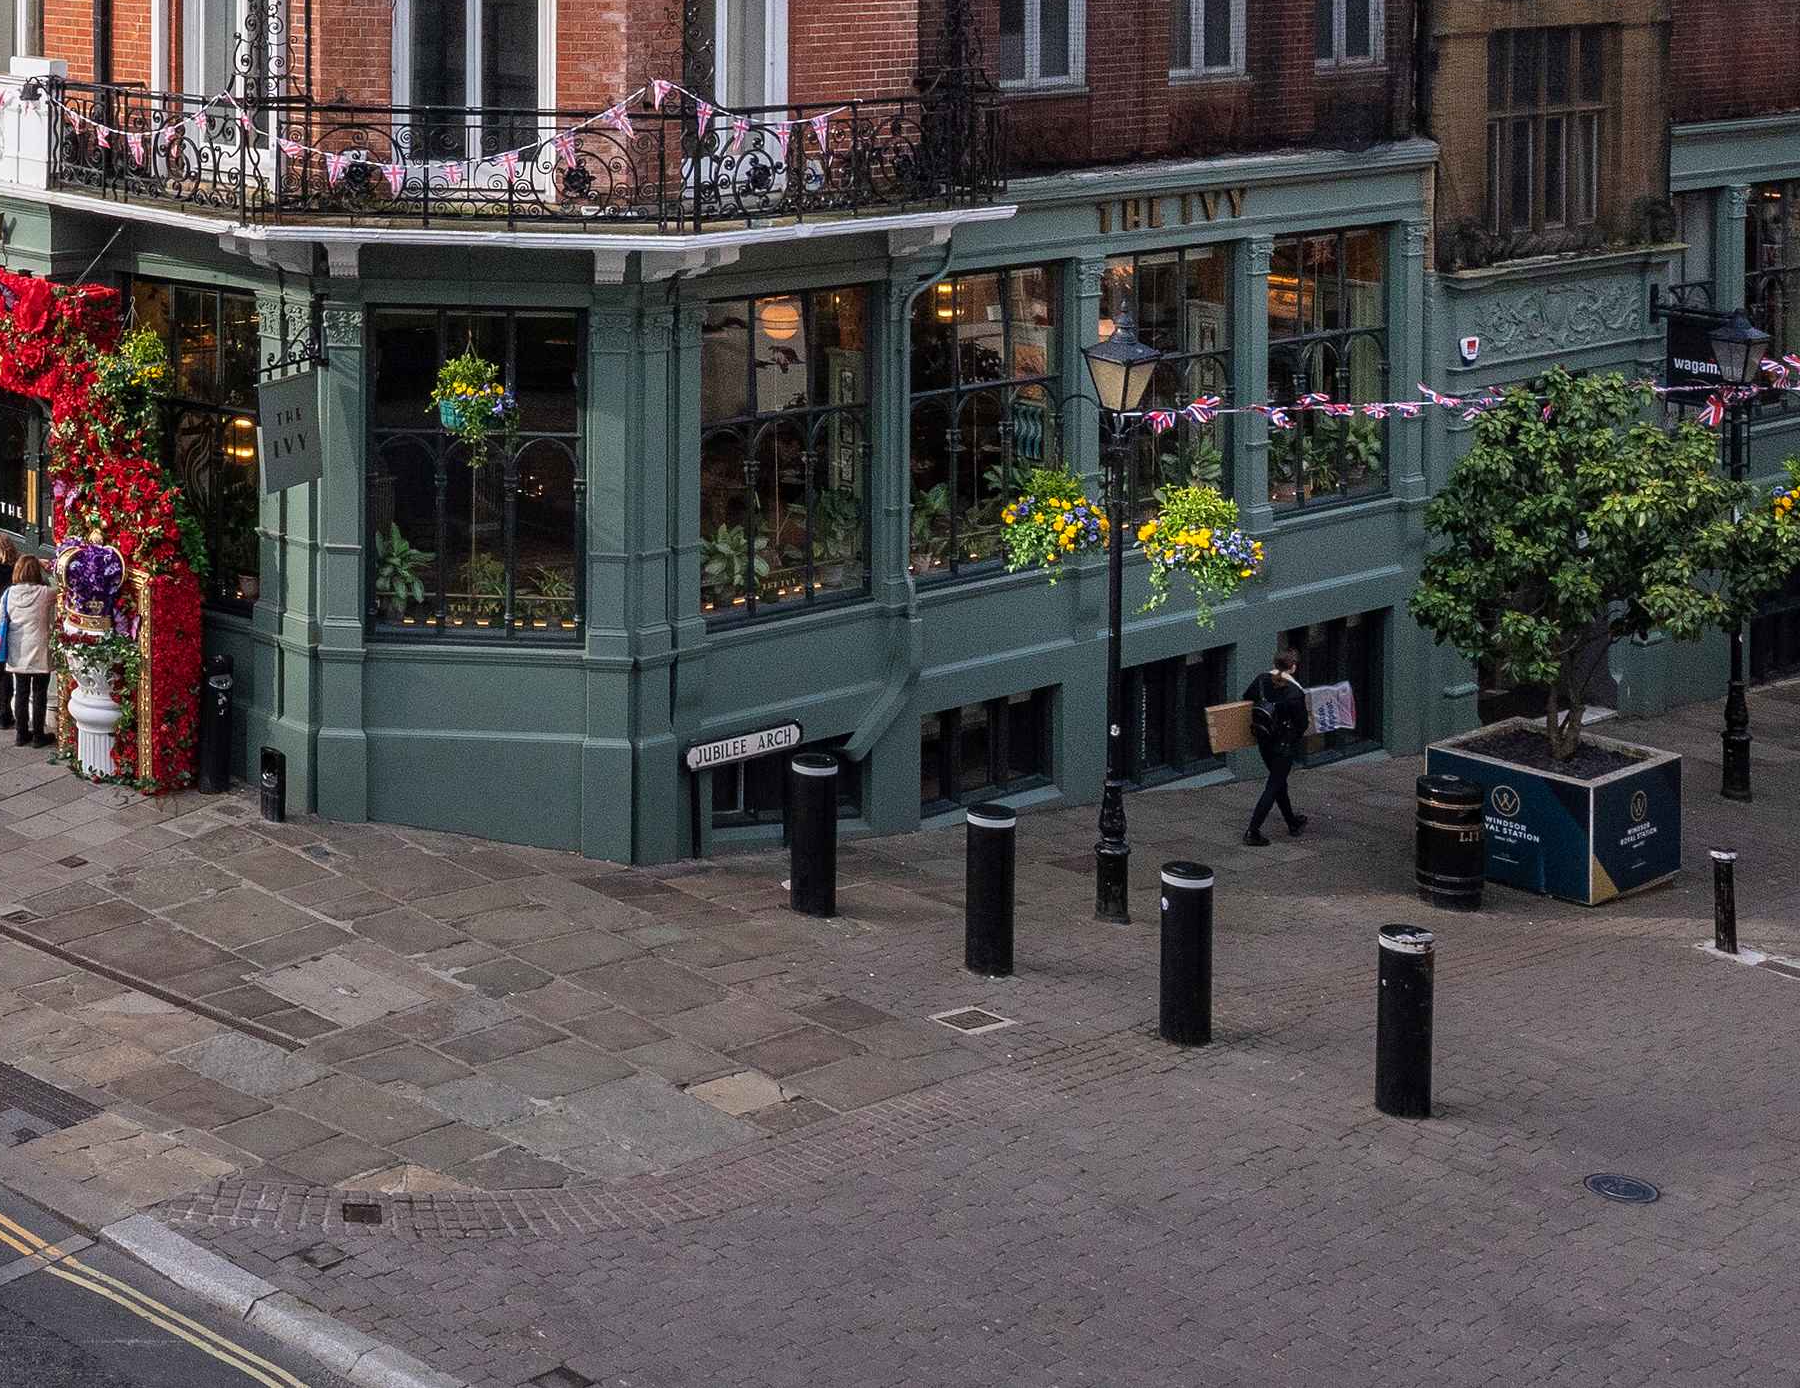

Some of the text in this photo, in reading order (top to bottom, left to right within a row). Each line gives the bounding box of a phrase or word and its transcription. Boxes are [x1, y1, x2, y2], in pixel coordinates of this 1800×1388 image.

[276, 407, 302, 425] THE
[273, 431, 308, 458] IVY
[0, 501, 23, 519] THE
[695, 727, 792, 765] JUBILEE ARCH
[1484, 815, 1527, 832] WINDSOR
[1484, 822, 1500, 833] YAL
[1502, 827, 1541, 843] STATION
